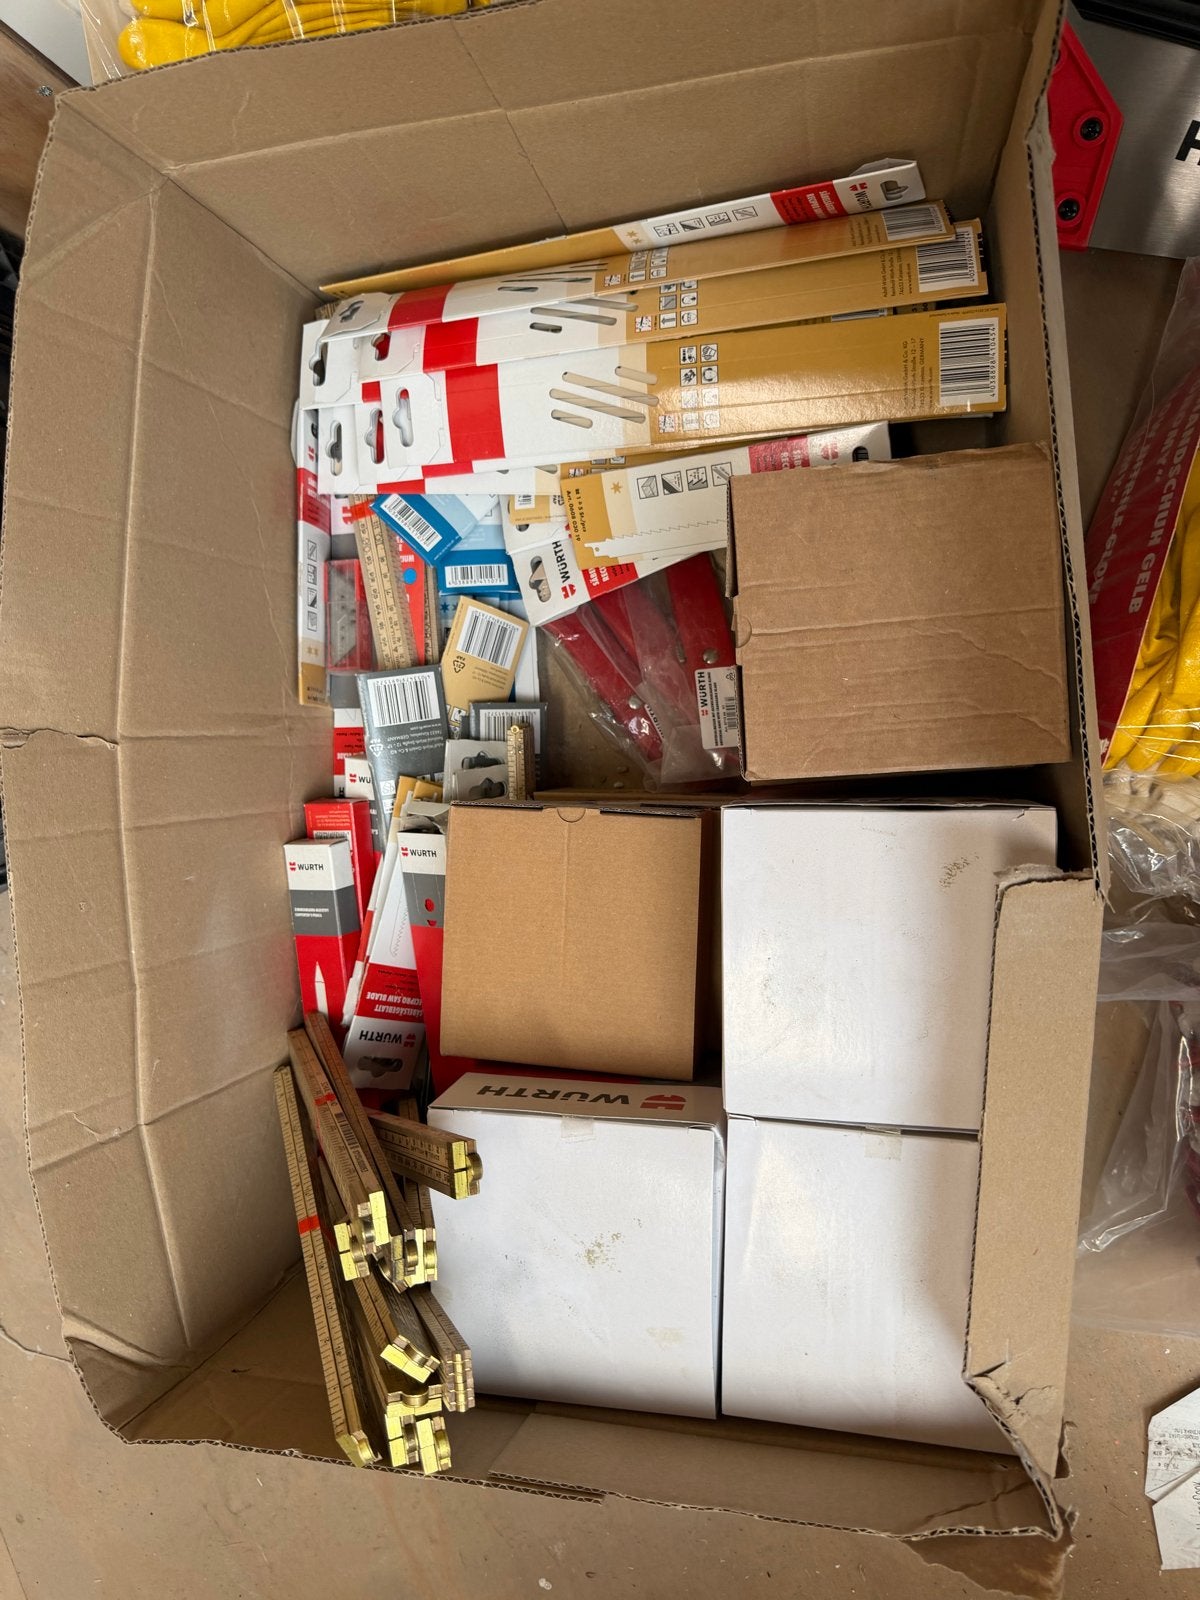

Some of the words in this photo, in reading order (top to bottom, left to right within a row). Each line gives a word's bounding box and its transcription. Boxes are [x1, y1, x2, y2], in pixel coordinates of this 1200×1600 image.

[565, 490, 574, 503] Art.
[567, 503, 577, 520] 0608
[552, 541, 567, 583] WÜRTH
[1128, 552, 1157, 614] GELB
[697, 671, 707, 707] WÜRTH
[409, 848, 437, 857] WÜRTH
[297, 862, 324, 872] WÜRTH
[366, 991, 387, 1001] BLADE
[387, 994, 401, 1003] SAW
[359, 1029, 403, 1045] WÜRTH
[477, 1085, 630, 1105] WÜRTH
